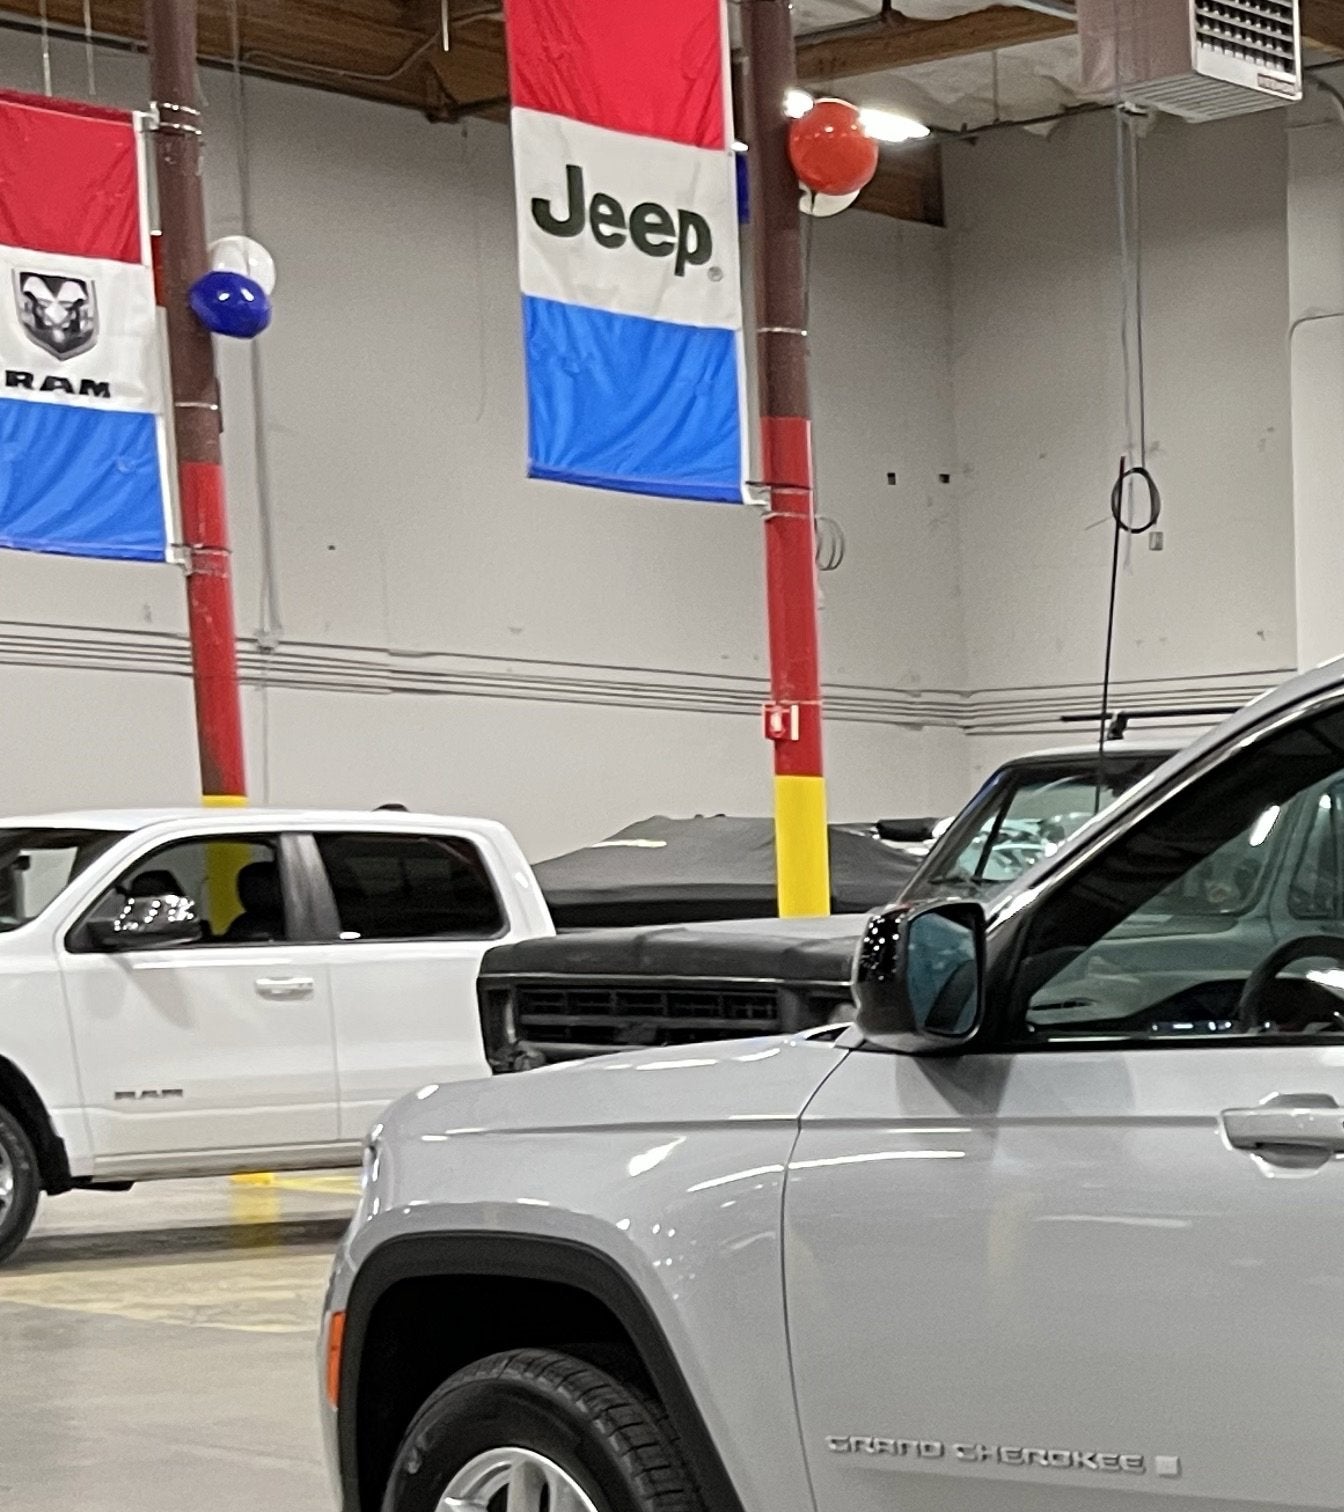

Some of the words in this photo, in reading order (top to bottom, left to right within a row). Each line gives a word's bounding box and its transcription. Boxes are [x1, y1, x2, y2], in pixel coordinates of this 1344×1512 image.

[532, 164, 713, 277] Jeep
[5, 370, 111, 398] RAM
[825, 1435, 945, 1459] GRAND
[952, 1443, 1146, 1476] CHEROKEE
